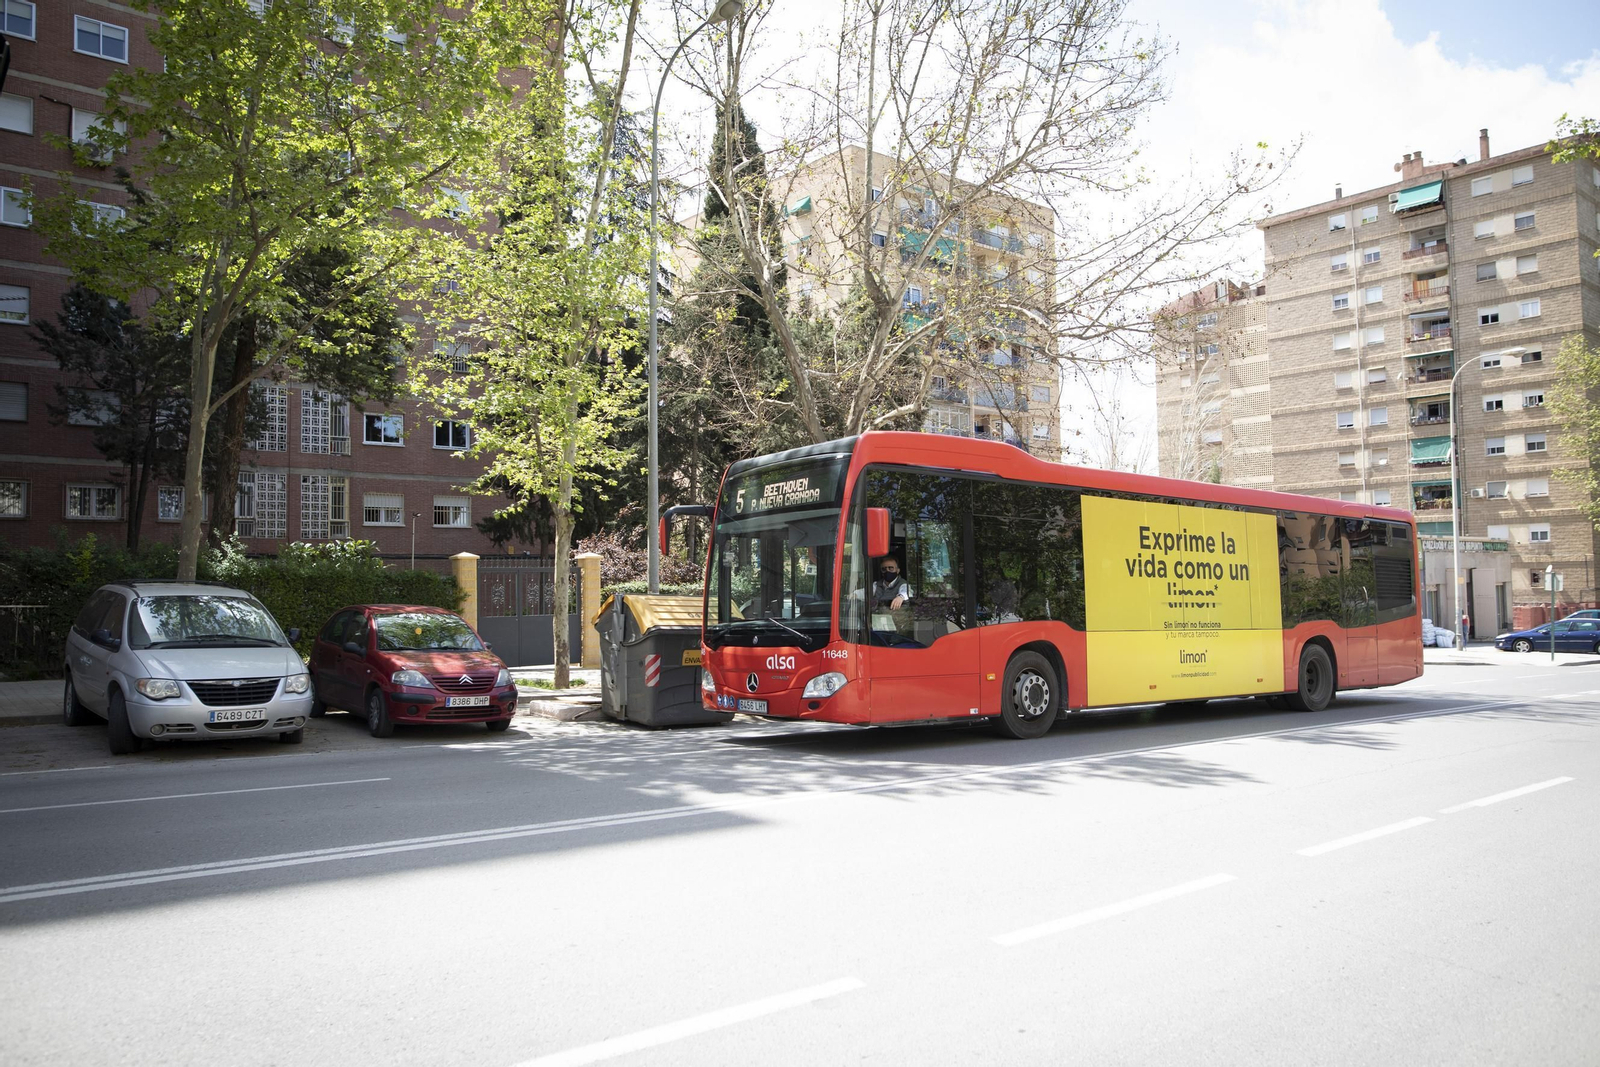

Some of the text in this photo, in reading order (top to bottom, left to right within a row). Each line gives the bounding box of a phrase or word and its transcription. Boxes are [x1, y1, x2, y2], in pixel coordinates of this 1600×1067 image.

[763, 477, 809, 497] BEETHOVEN
[735, 489, 746, 514] 5
[759, 494, 783, 511] NUEVA
[784, 488, 820, 506] GRANADA
[1139, 525, 1236, 556] Exprime la
[1125, 552, 1250, 581] vida como un
[1163, 621, 1174, 629] Sin
[1198, 620, 1222, 629] funciona
[1165, 632, 1170, 640] y
[1195, 631, 1220, 639] tampoco.
[766, 654, 795, 670] alsa
[822, 650, 848, 659] 11648
[452, 696, 489, 706] 8386 DHP
[216, 710, 264, 721] 6489 CZT
